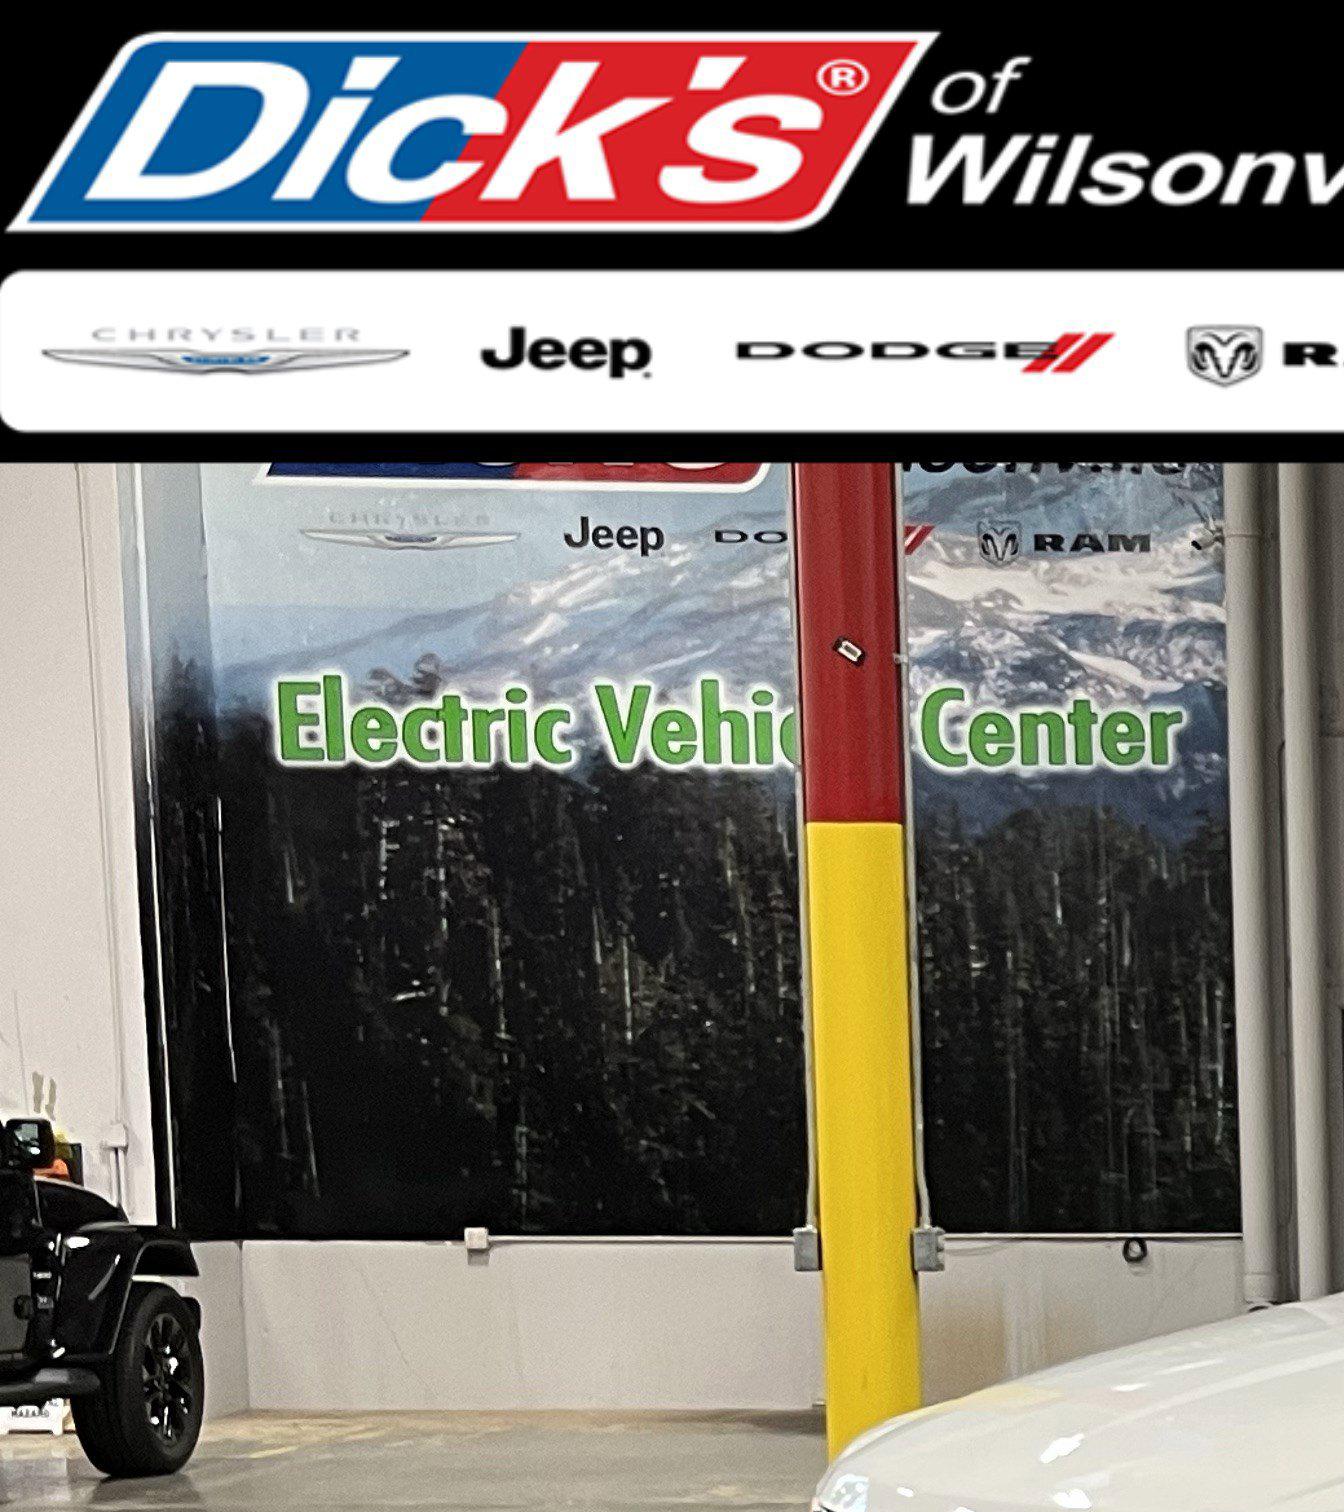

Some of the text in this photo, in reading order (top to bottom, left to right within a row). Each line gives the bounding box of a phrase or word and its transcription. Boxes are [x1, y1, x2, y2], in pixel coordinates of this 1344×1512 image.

[564, 515, 665, 557] Jeep
[1033, 533, 1152, 553] RAM
[276, 673, 1184, 768] Electric Vehi Center
